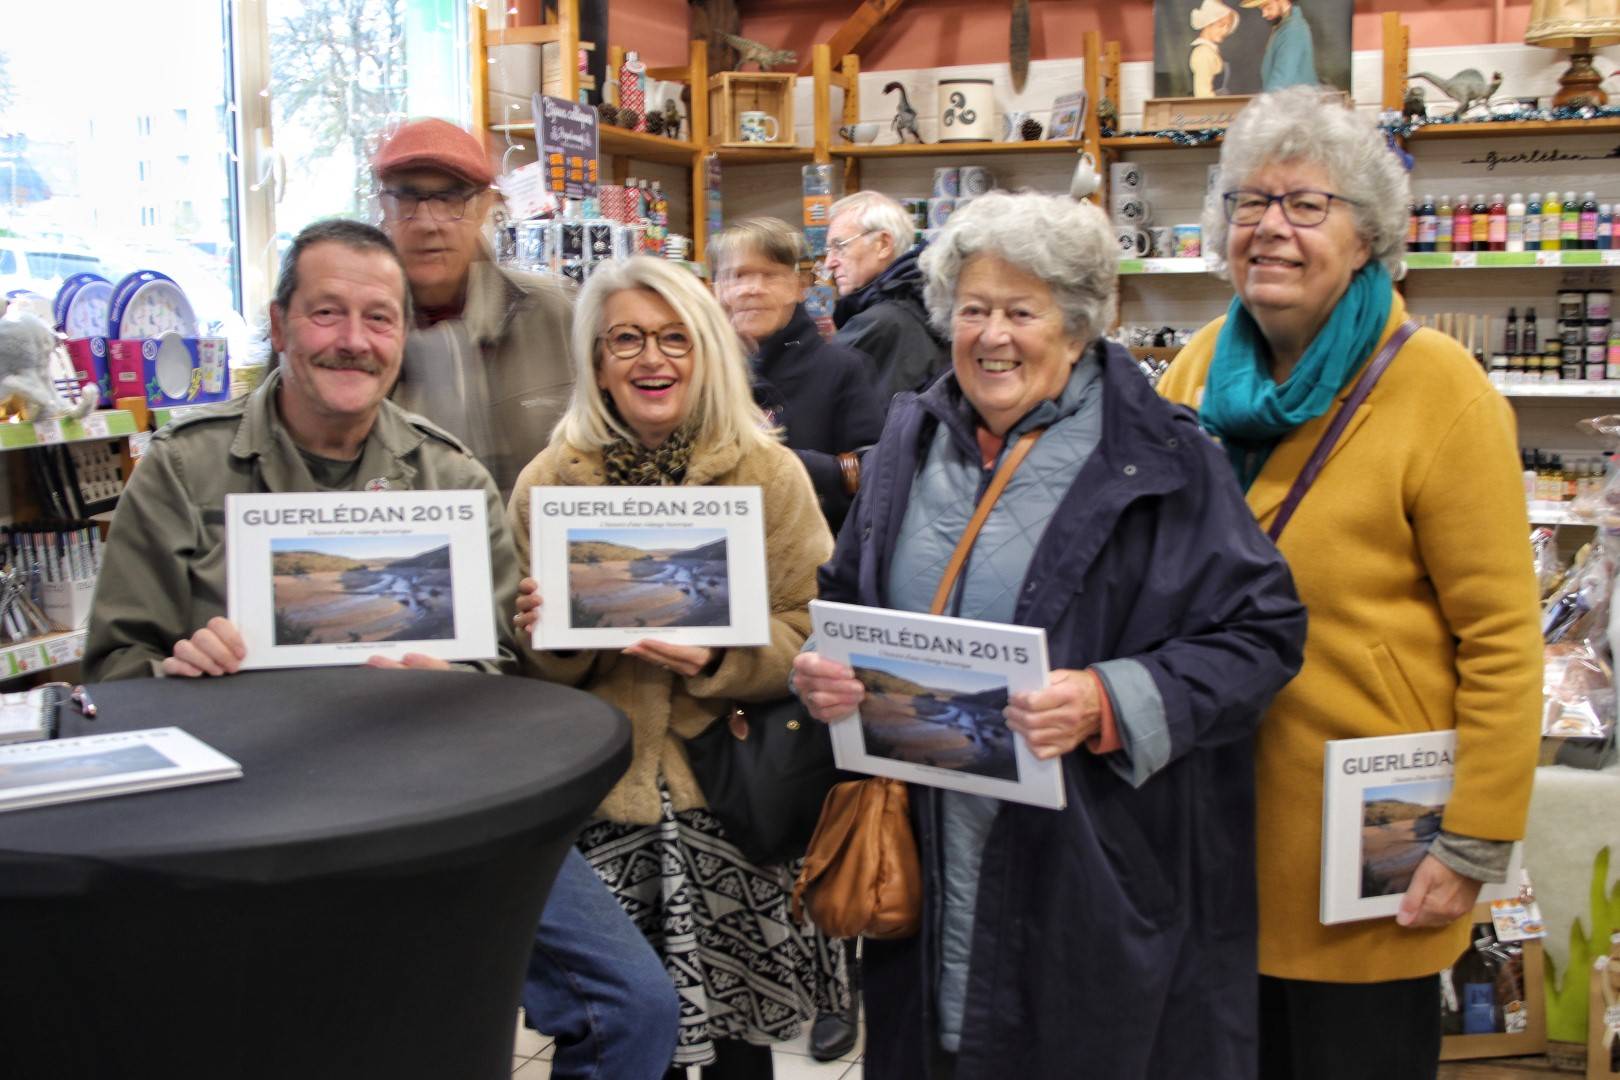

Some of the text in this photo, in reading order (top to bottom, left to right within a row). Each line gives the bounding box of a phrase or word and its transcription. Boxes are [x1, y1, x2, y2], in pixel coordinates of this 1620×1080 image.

[243, 503, 475, 525] GUERLÉDAN 2015
[542, 497, 749, 517] GUERLÉDAN 2015
[823, 621, 963, 654] GUERLÉDAN
[969, 640, 1029, 664] 2015
[1342, 747, 1455, 775] GUERLÉDA
